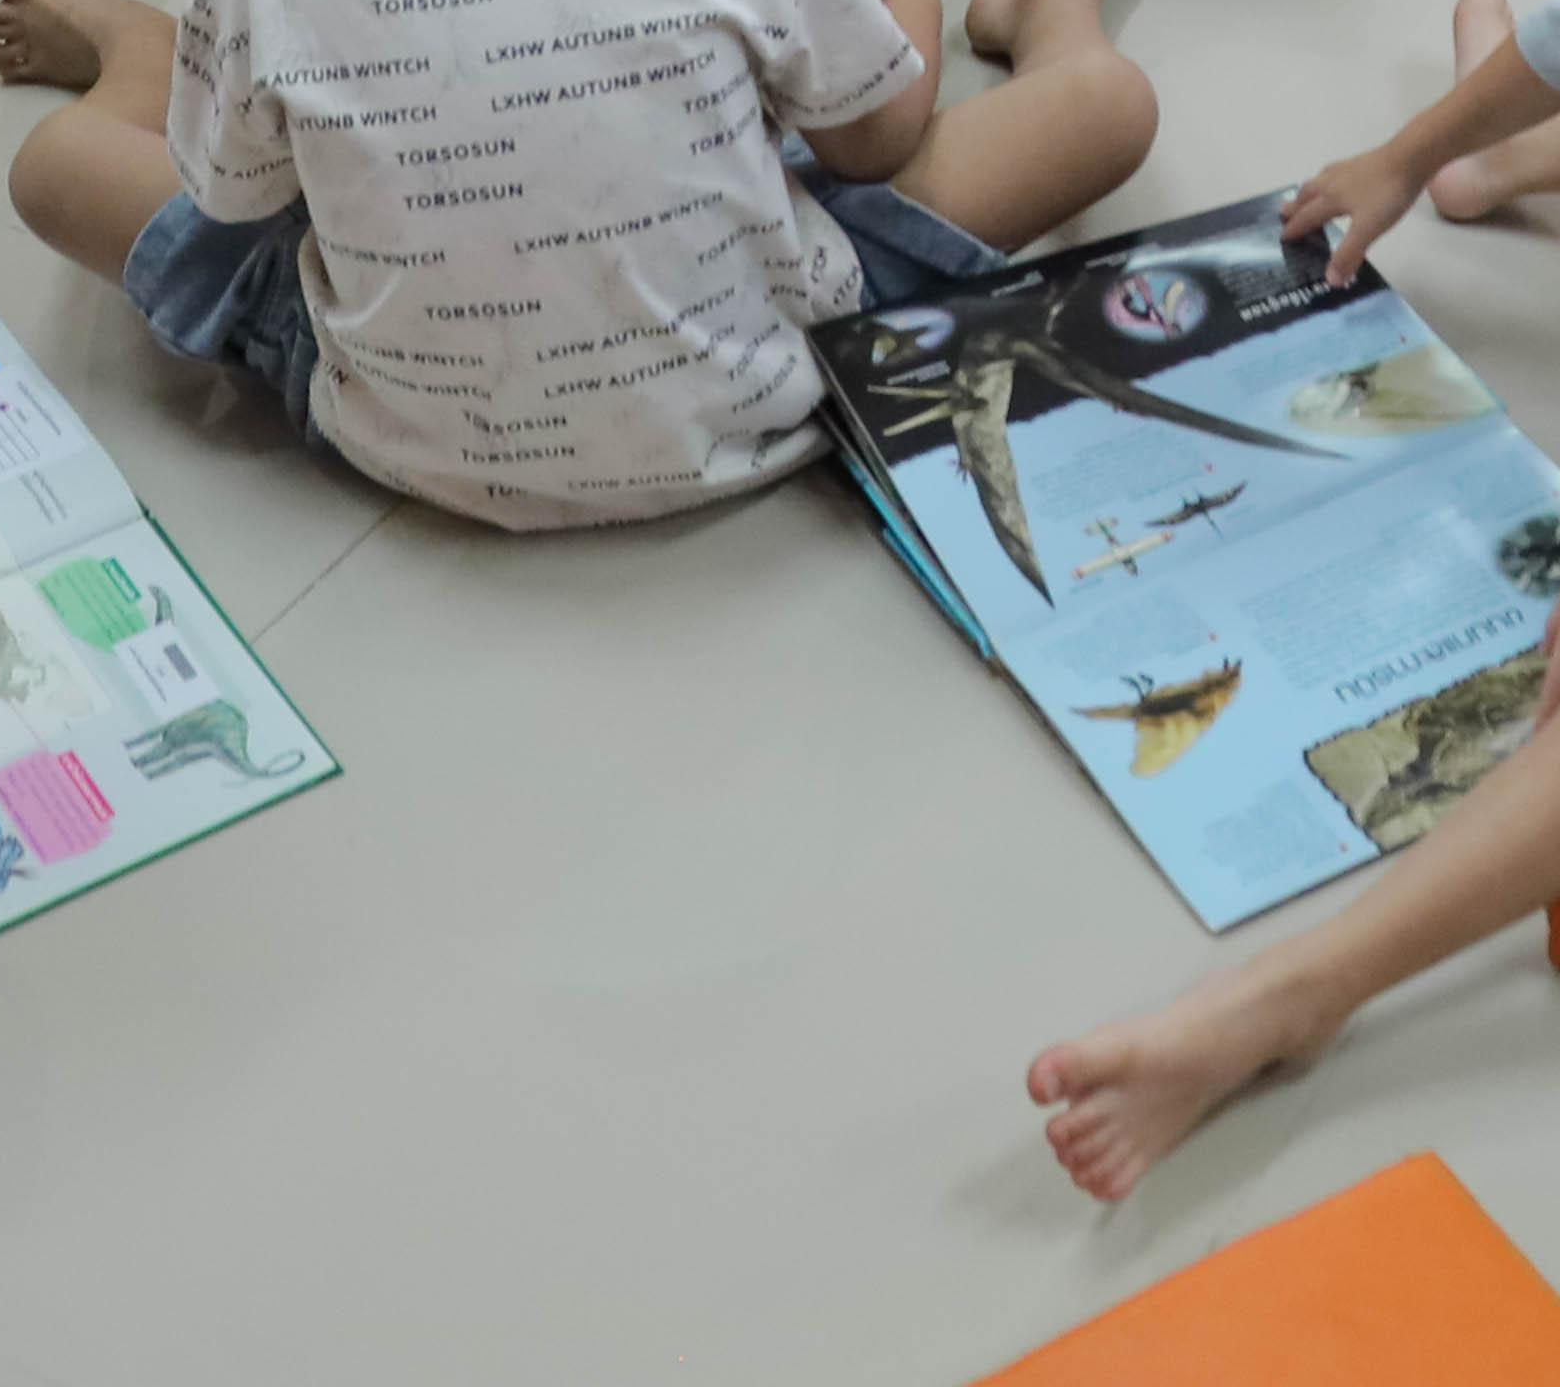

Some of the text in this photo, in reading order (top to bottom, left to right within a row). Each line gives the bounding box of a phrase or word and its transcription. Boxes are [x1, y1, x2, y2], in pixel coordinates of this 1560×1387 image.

[485, 12, 720, 64] LXHW AUTUNB WINTCH
[354, 56, 432, 78] WINTCH
[491, 90, 551, 113] LXHW
[557, 74, 641, 101] AUTUNB
[360, 105, 438, 128] WINTCH
[396, 137, 517, 167] TORSOSUN
[403, 183, 524, 212] TORSOSUN
[514, 231, 569, 255] LXHW
[425, 299, 541, 321] TORSOSUN
